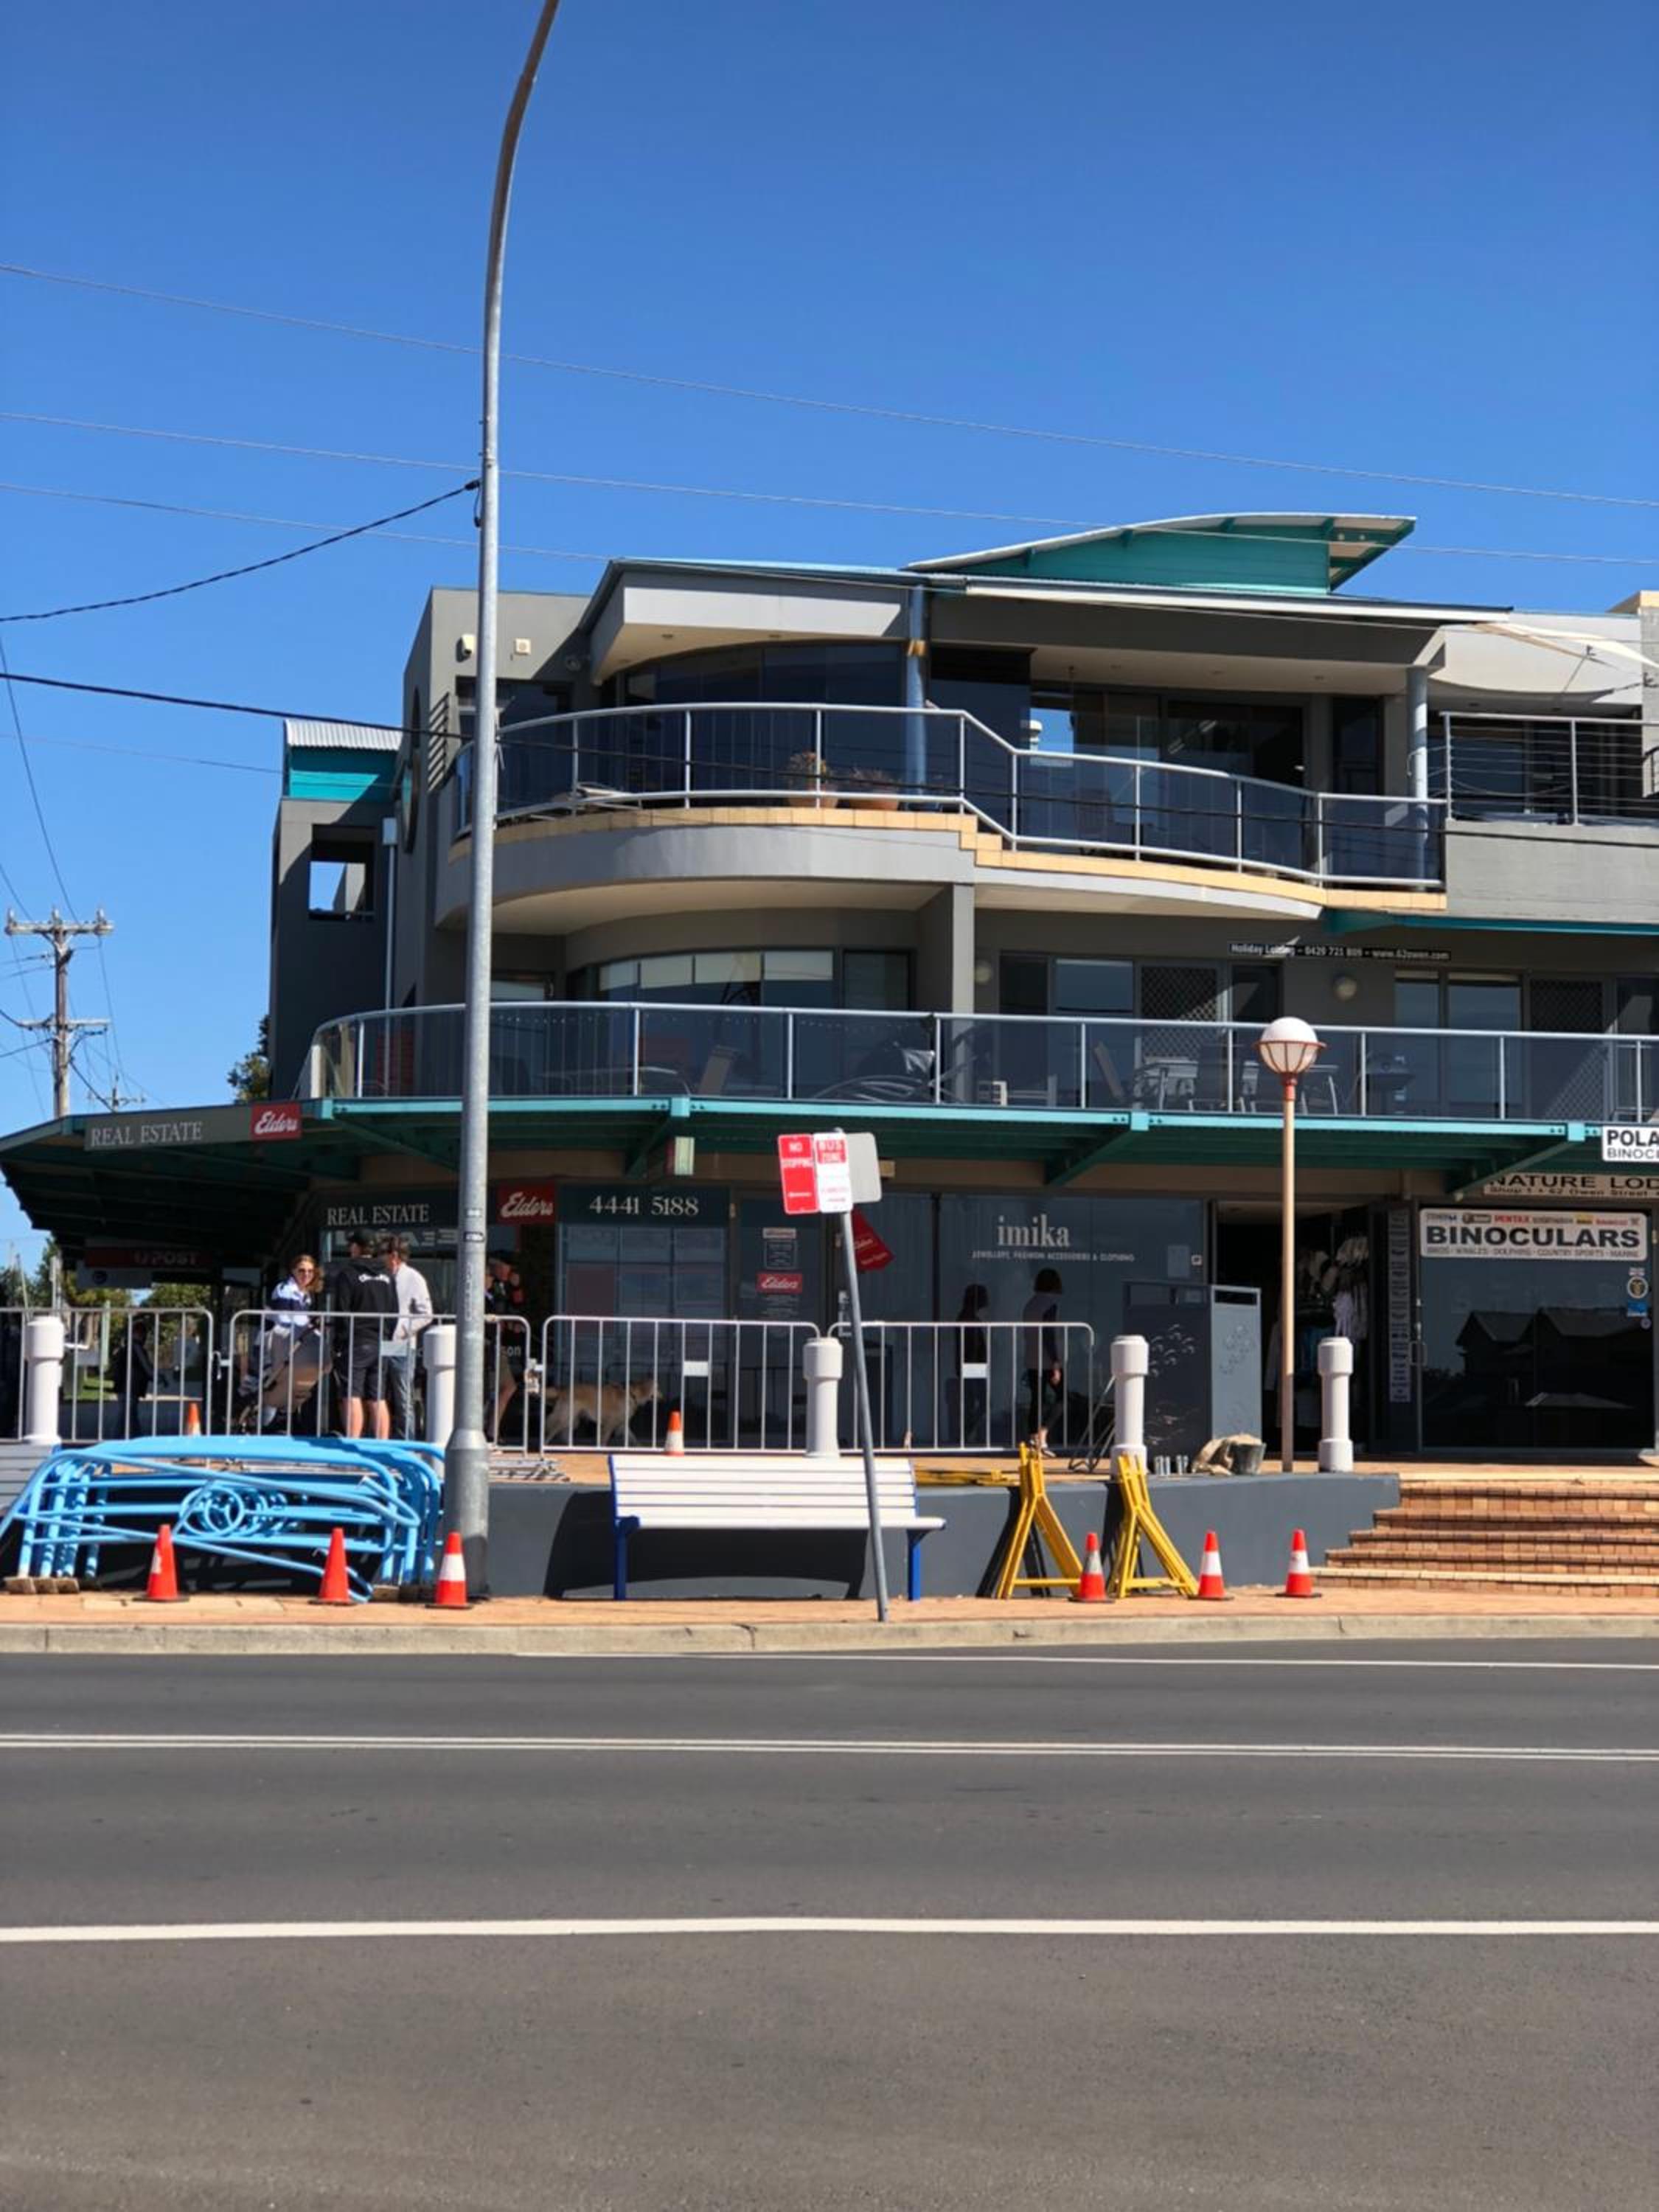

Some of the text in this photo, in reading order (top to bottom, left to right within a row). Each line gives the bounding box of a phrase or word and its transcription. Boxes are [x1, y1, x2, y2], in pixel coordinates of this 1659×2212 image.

[1265, 945, 1295, 957] Letg
[254, 1110, 299, 1134] Elders
[91, 1121, 202, 1147] REAL ESTATE
[819, 1139, 843, 1151] BUS
[1607, 1130, 1659, 1146] POLA
[1489, 1175, 1596, 1188] NATURE
[327, 1203, 430, 1225] REAL ESTATE
[500, 1192, 554, 1218] Elders
[589, 1195, 700, 1216] 4441 5188
[997, 1214, 1071, 1247] imika
[1426, 1226, 1641, 1248] BINOCULARS
